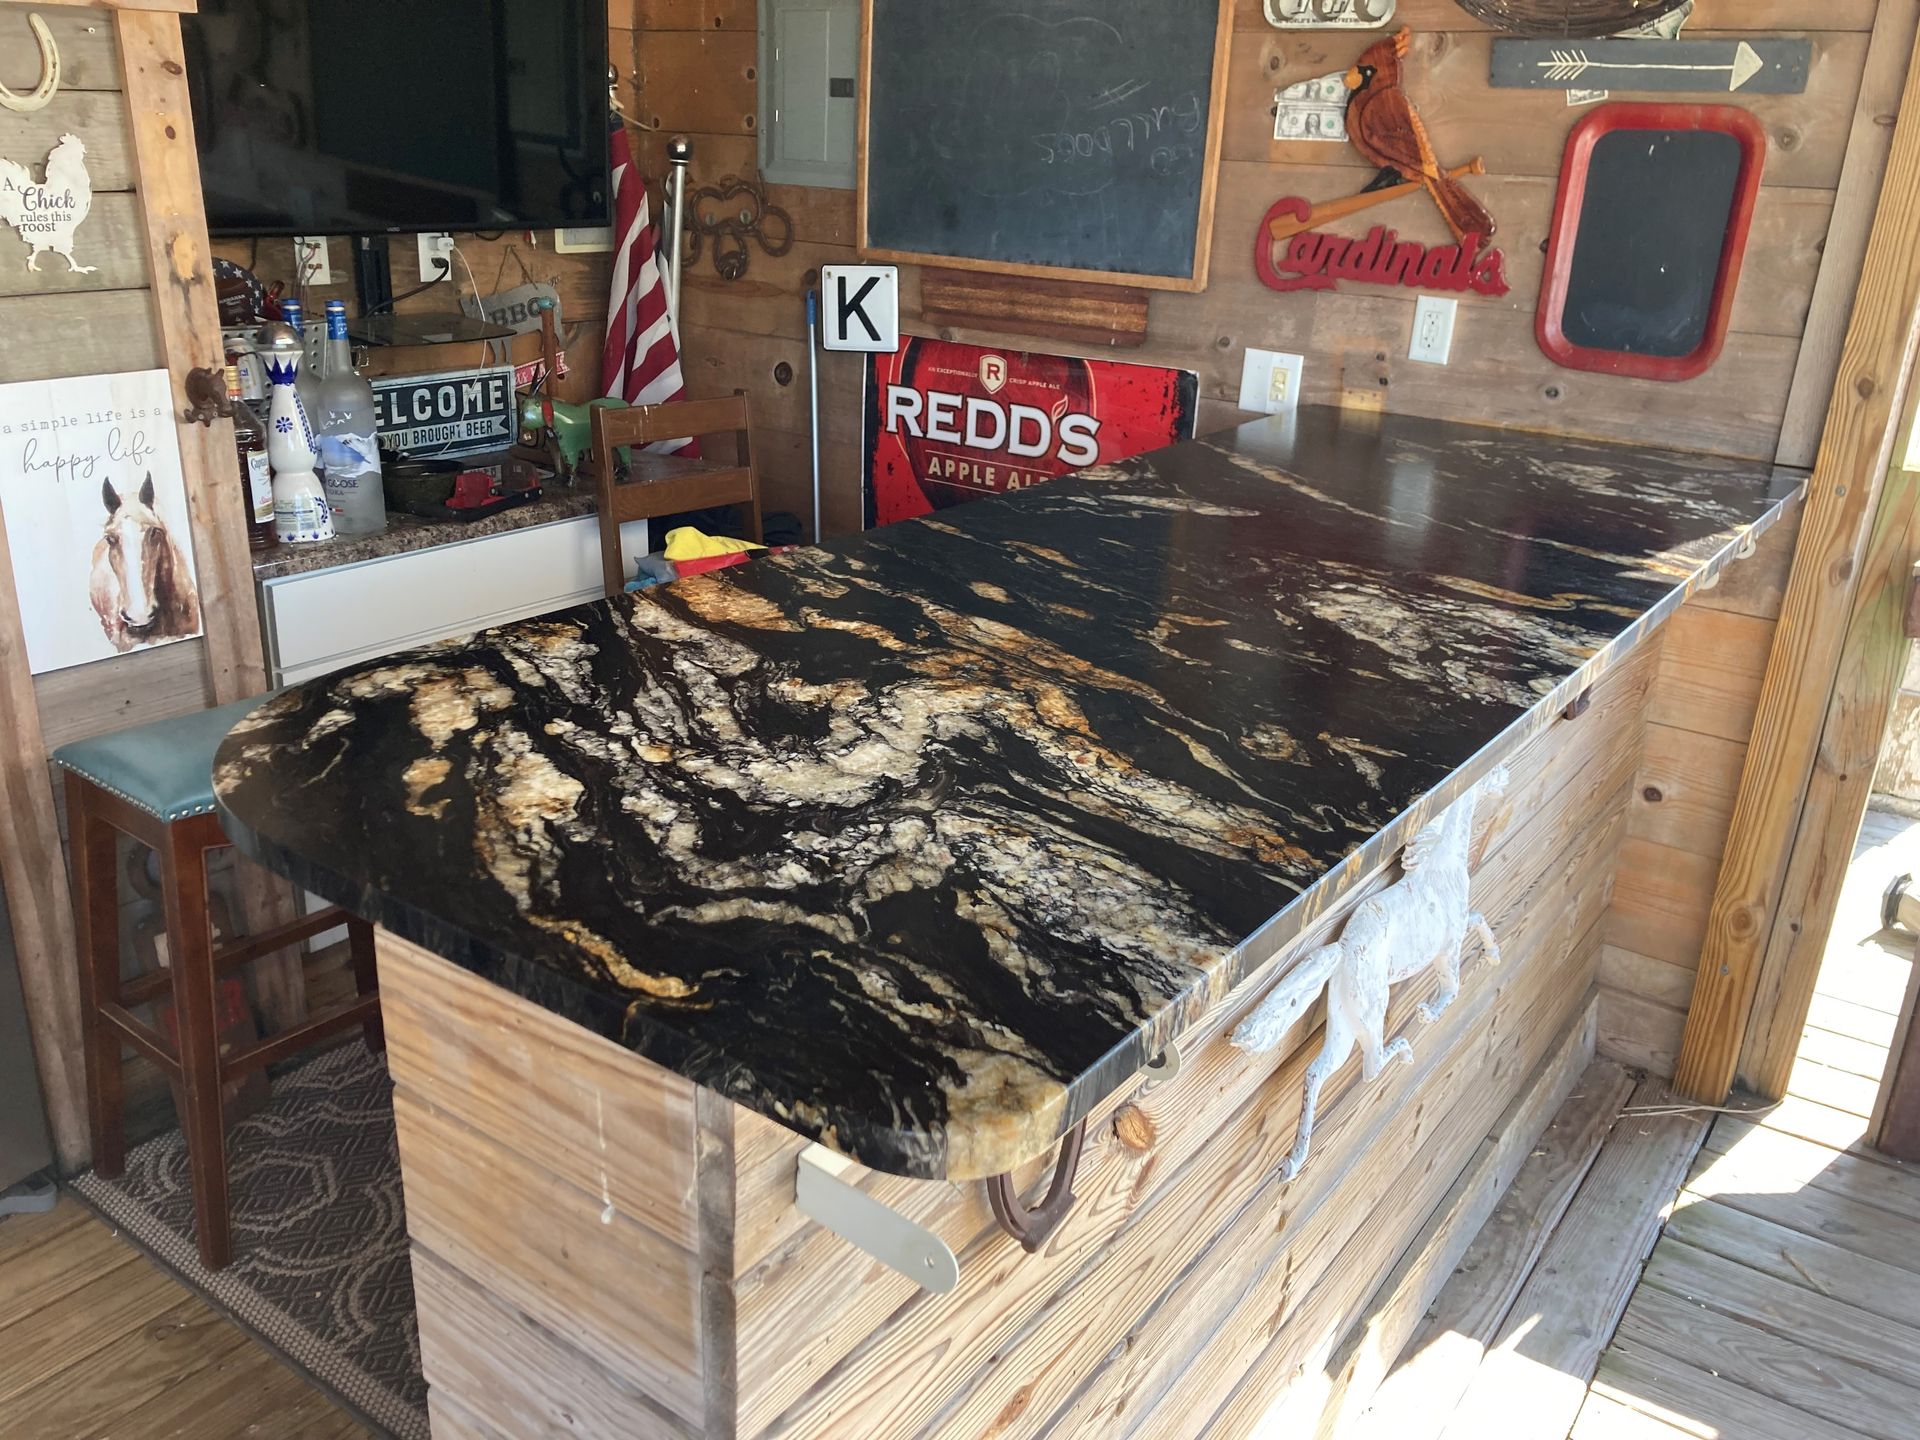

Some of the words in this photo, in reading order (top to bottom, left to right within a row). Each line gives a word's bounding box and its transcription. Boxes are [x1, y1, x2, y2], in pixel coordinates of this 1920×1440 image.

[3, 177, 15, 191] A
[18, 186, 76, 211] Chick
[20, 212, 48, 222] rules
[51, 211, 72, 221] this
[22, 223, 56, 232] roost
[1255, 196, 1511, 297] Cardinals
[837, 276, 882, 341] K
[937, 367, 978, 378] EXCEPTIONALLY
[987, 363, 1001, 381] R
[1009, 377, 1027, 385] CRISP
[1028, 380, 1047, 388] APPLE
[373, 380, 504, 426] ELCOME
[3, 425, 12, 434] a
[21, 416, 78, 432] simple
[87, 410, 122, 425] life
[131, 408, 146, 419] is
[154, 407, 161, 416] a
[413, 425, 460, 445] BROUGHT
[466, 420, 493, 437] BEER
[886, 385, 1102, 467] REDD'S
[23, 438, 101, 483] happy
[108, 427, 156, 466] life
[928, 456, 996, 486] APPLE
